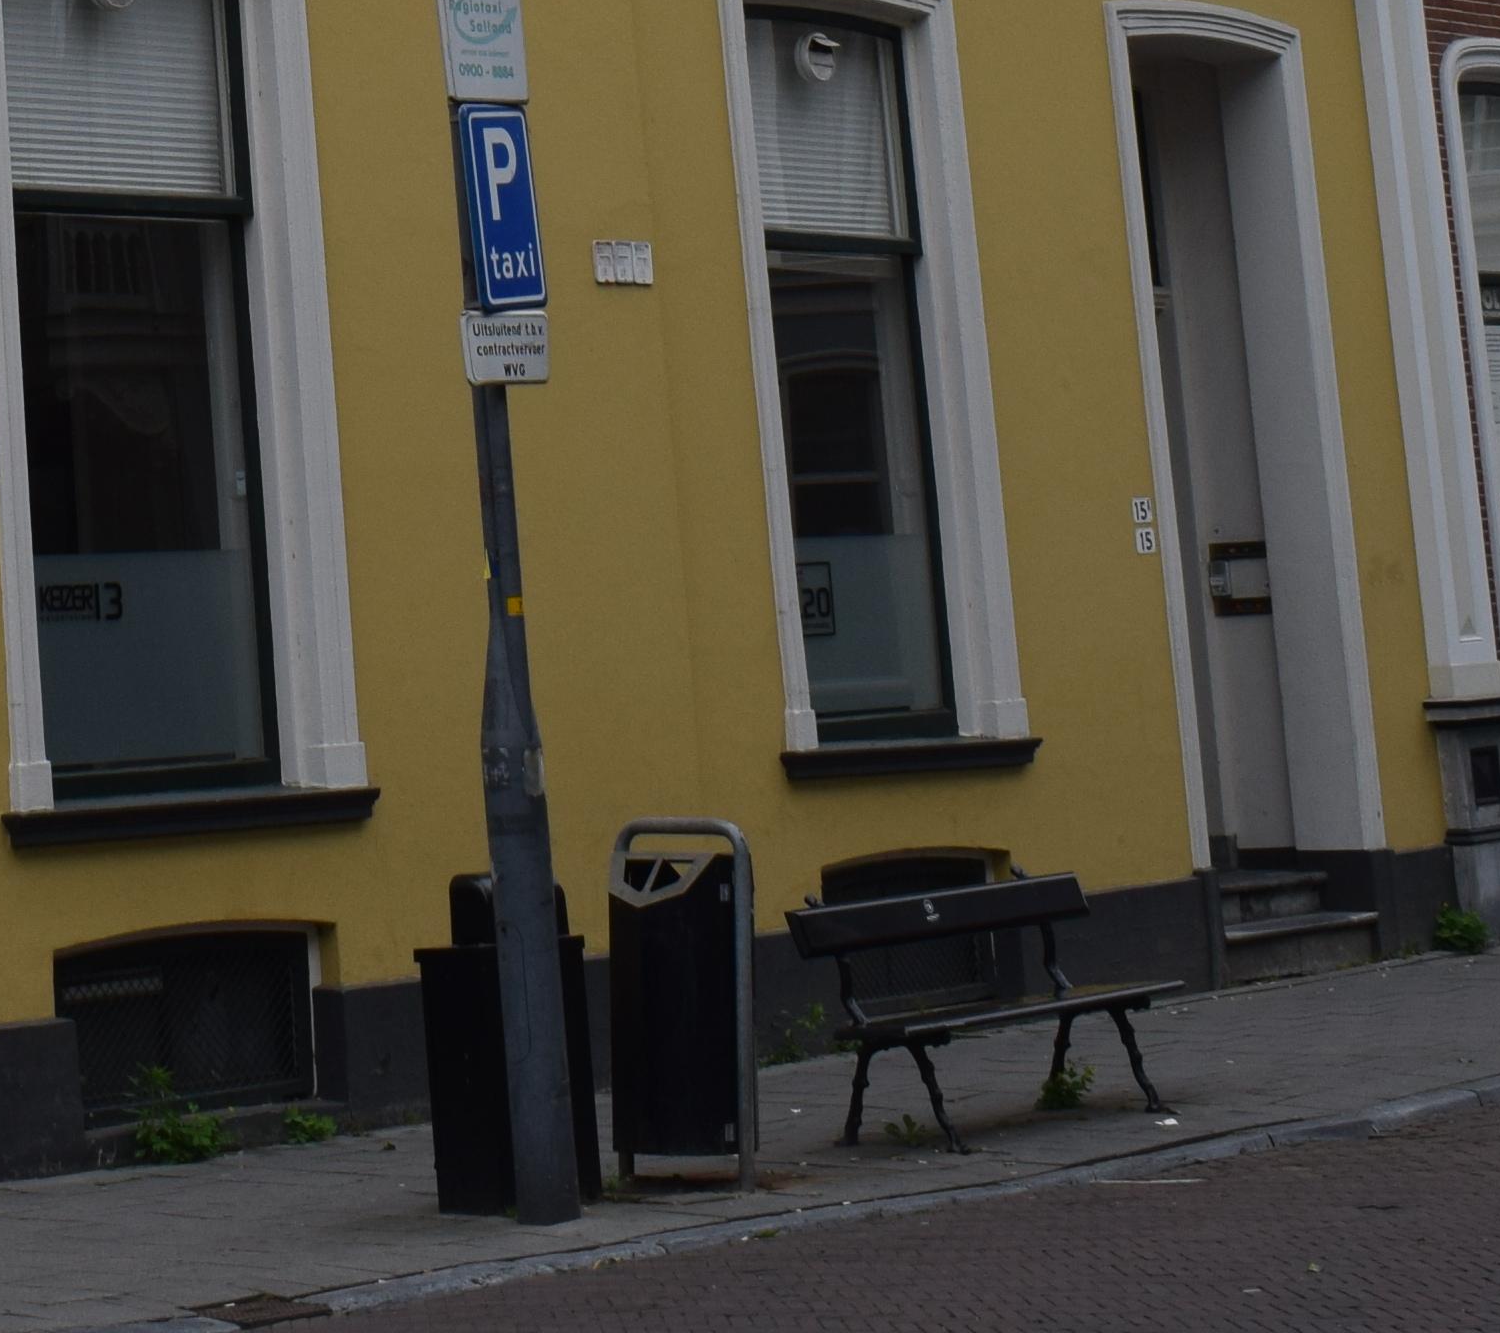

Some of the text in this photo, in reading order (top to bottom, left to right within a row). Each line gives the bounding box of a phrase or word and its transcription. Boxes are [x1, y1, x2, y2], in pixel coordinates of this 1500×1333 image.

[459, 62, 483, 77] 0900
[483, 127, 517, 221] P
[490, 243, 535, 280] taxi
[472, 322, 522, 337] Uitsluitend
[503, 363, 526, 377] WVG
[1140, 531, 1153, 551] 15
